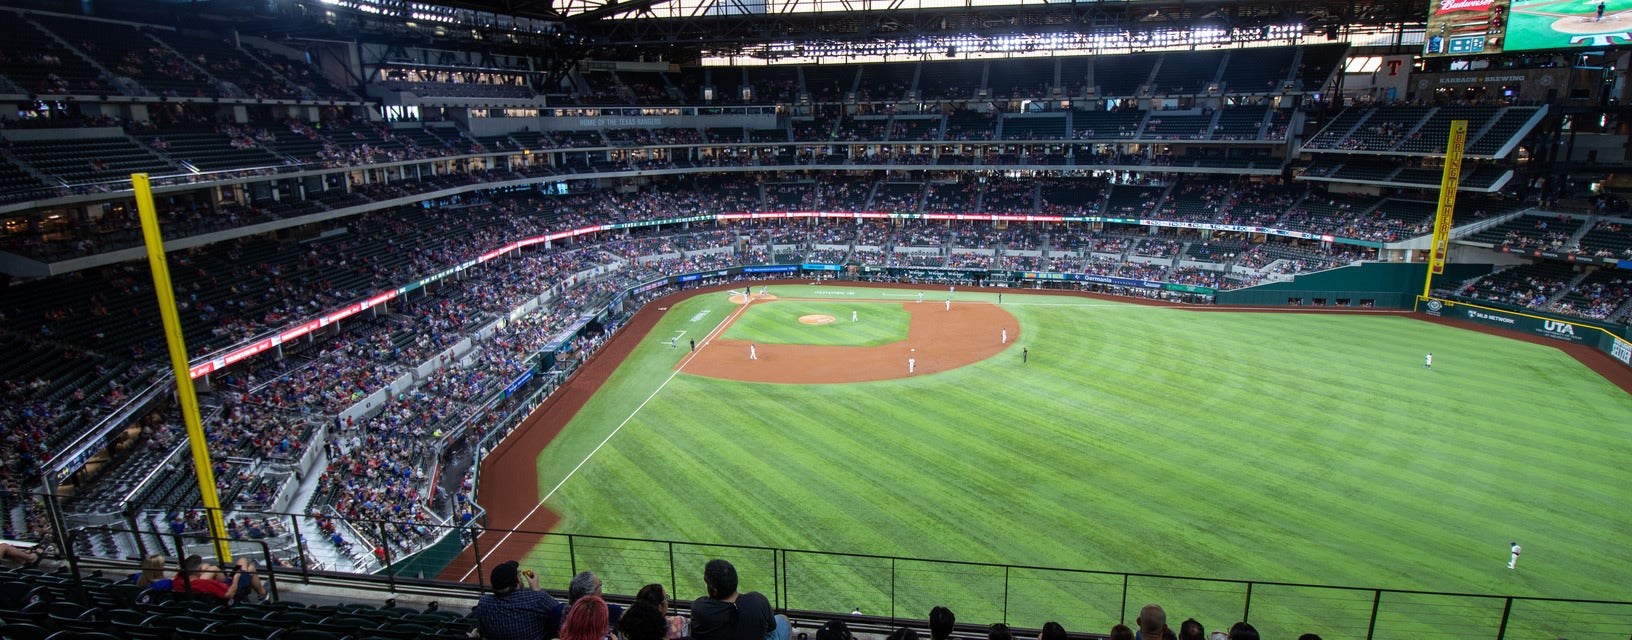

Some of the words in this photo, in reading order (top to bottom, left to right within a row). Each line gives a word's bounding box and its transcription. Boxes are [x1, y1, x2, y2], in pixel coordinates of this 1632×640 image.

[1440, 0, 1495, 10] Budweiser
[1449, 134, 1464, 178] BRING
[1445, 180, 1456, 205] THE
[1084, 275, 1112, 283] Germania
[1489, 314, 1515, 324] NETWORK
[1544, 320, 1574, 335] UTA
[1611, 343, 1631, 365] SELTZER
